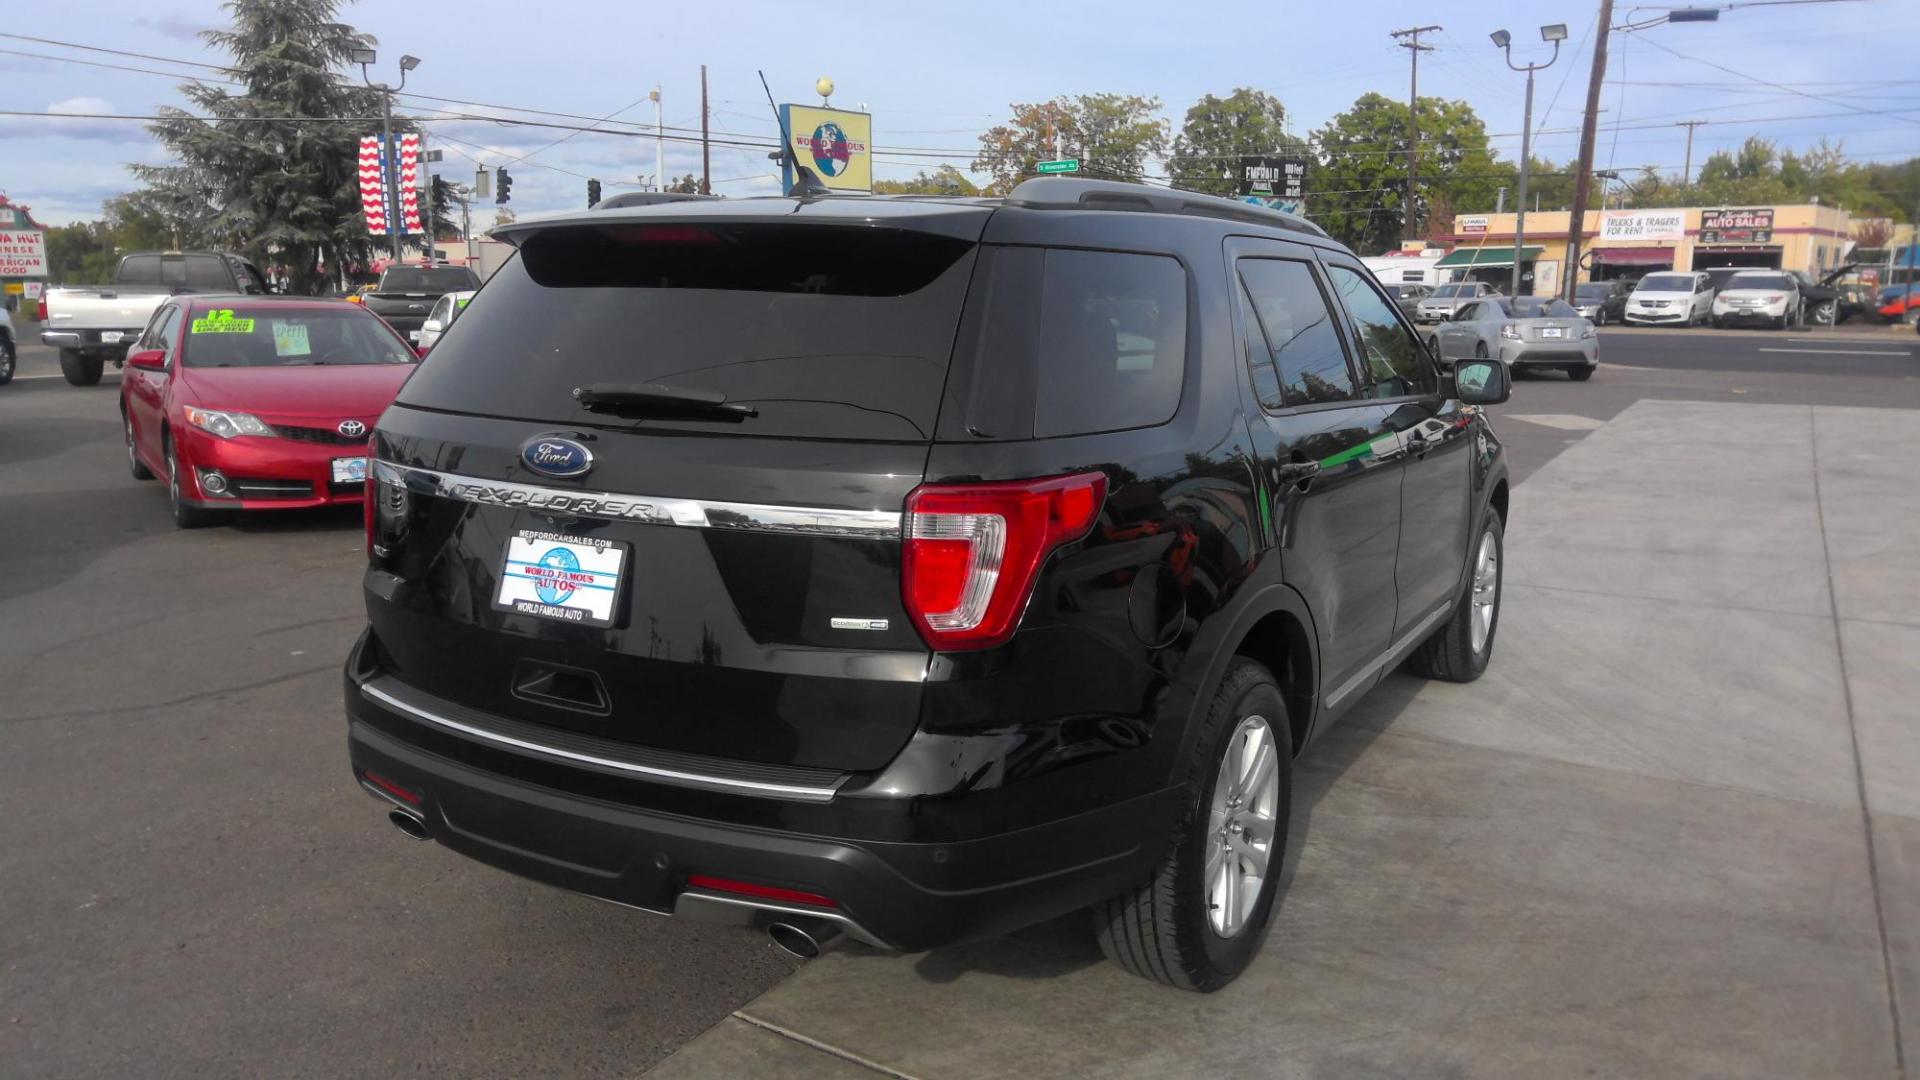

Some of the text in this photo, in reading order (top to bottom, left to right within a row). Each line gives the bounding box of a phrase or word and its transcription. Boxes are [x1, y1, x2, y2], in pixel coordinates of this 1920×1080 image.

[1245, 166, 1279, 182] EMERALD
[1606, 216, 1634, 227] TRUCKS
[1645, 216, 1680, 227] TRAILERS
[1705, 217, 1769, 228] AUTO SALES
[16, 233, 40, 243] HUT
[1606, 227, 1621, 236] FOR
[1624, 226, 1643, 235] RENT
[207, 309, 235, 321] 12
[533, 442, 572, 465] Ford
[462, 484, 653, 519] EXPLORER
[519, 529, 612, 548] MEDFORDCARSALES.COM
[524, 566, 595, 584] WORLD FAMOUS
[536, 576, 577, 592] AUTOS
[516, 602, 582, 621] WORLD FAMOUS AUTO
